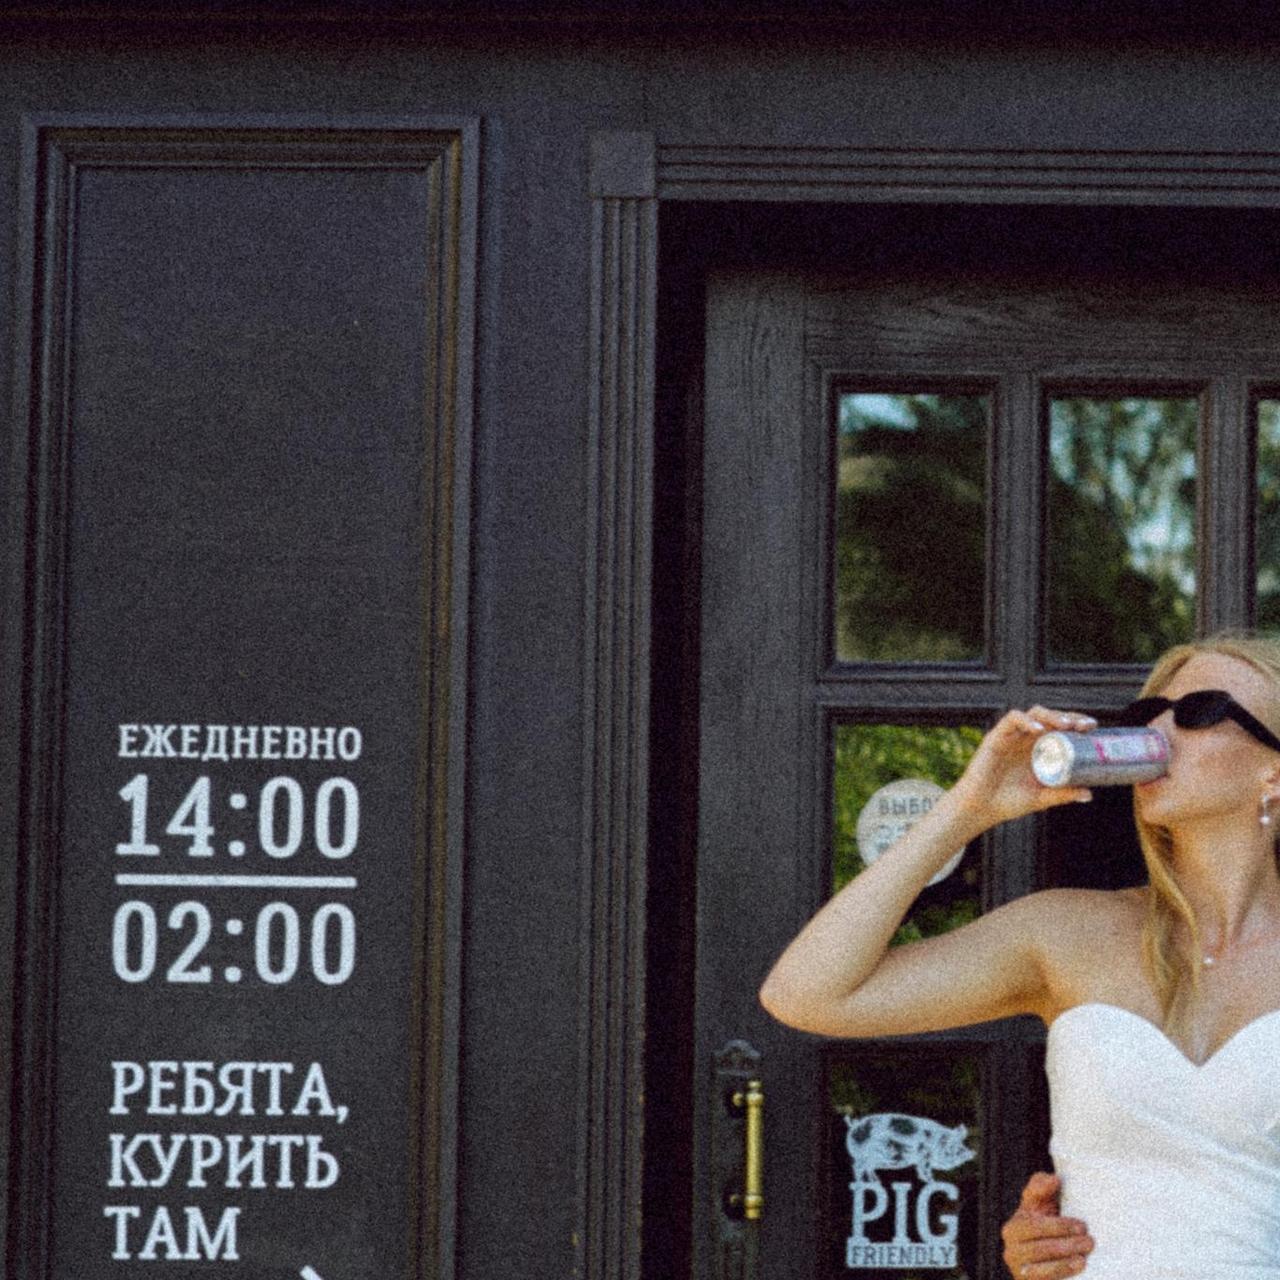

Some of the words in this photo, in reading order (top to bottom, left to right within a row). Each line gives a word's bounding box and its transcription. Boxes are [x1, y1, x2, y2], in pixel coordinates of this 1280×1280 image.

[118, 724, 363, 762] ЕЖЕДНЕВНО
[114, 773, 360, 859] 14:00
[111, 900, 356, 985] 02:00
[109, 1061, 349, 1123] РЕБЯТА,
[107, 1133, 340, 1189] КУРИТЬ
[103, 1205, 241, 1261] ТАМ
[849, 1182, 960, 1243] PIG
[851, 1245, 956, 1265] FRIENDLY
